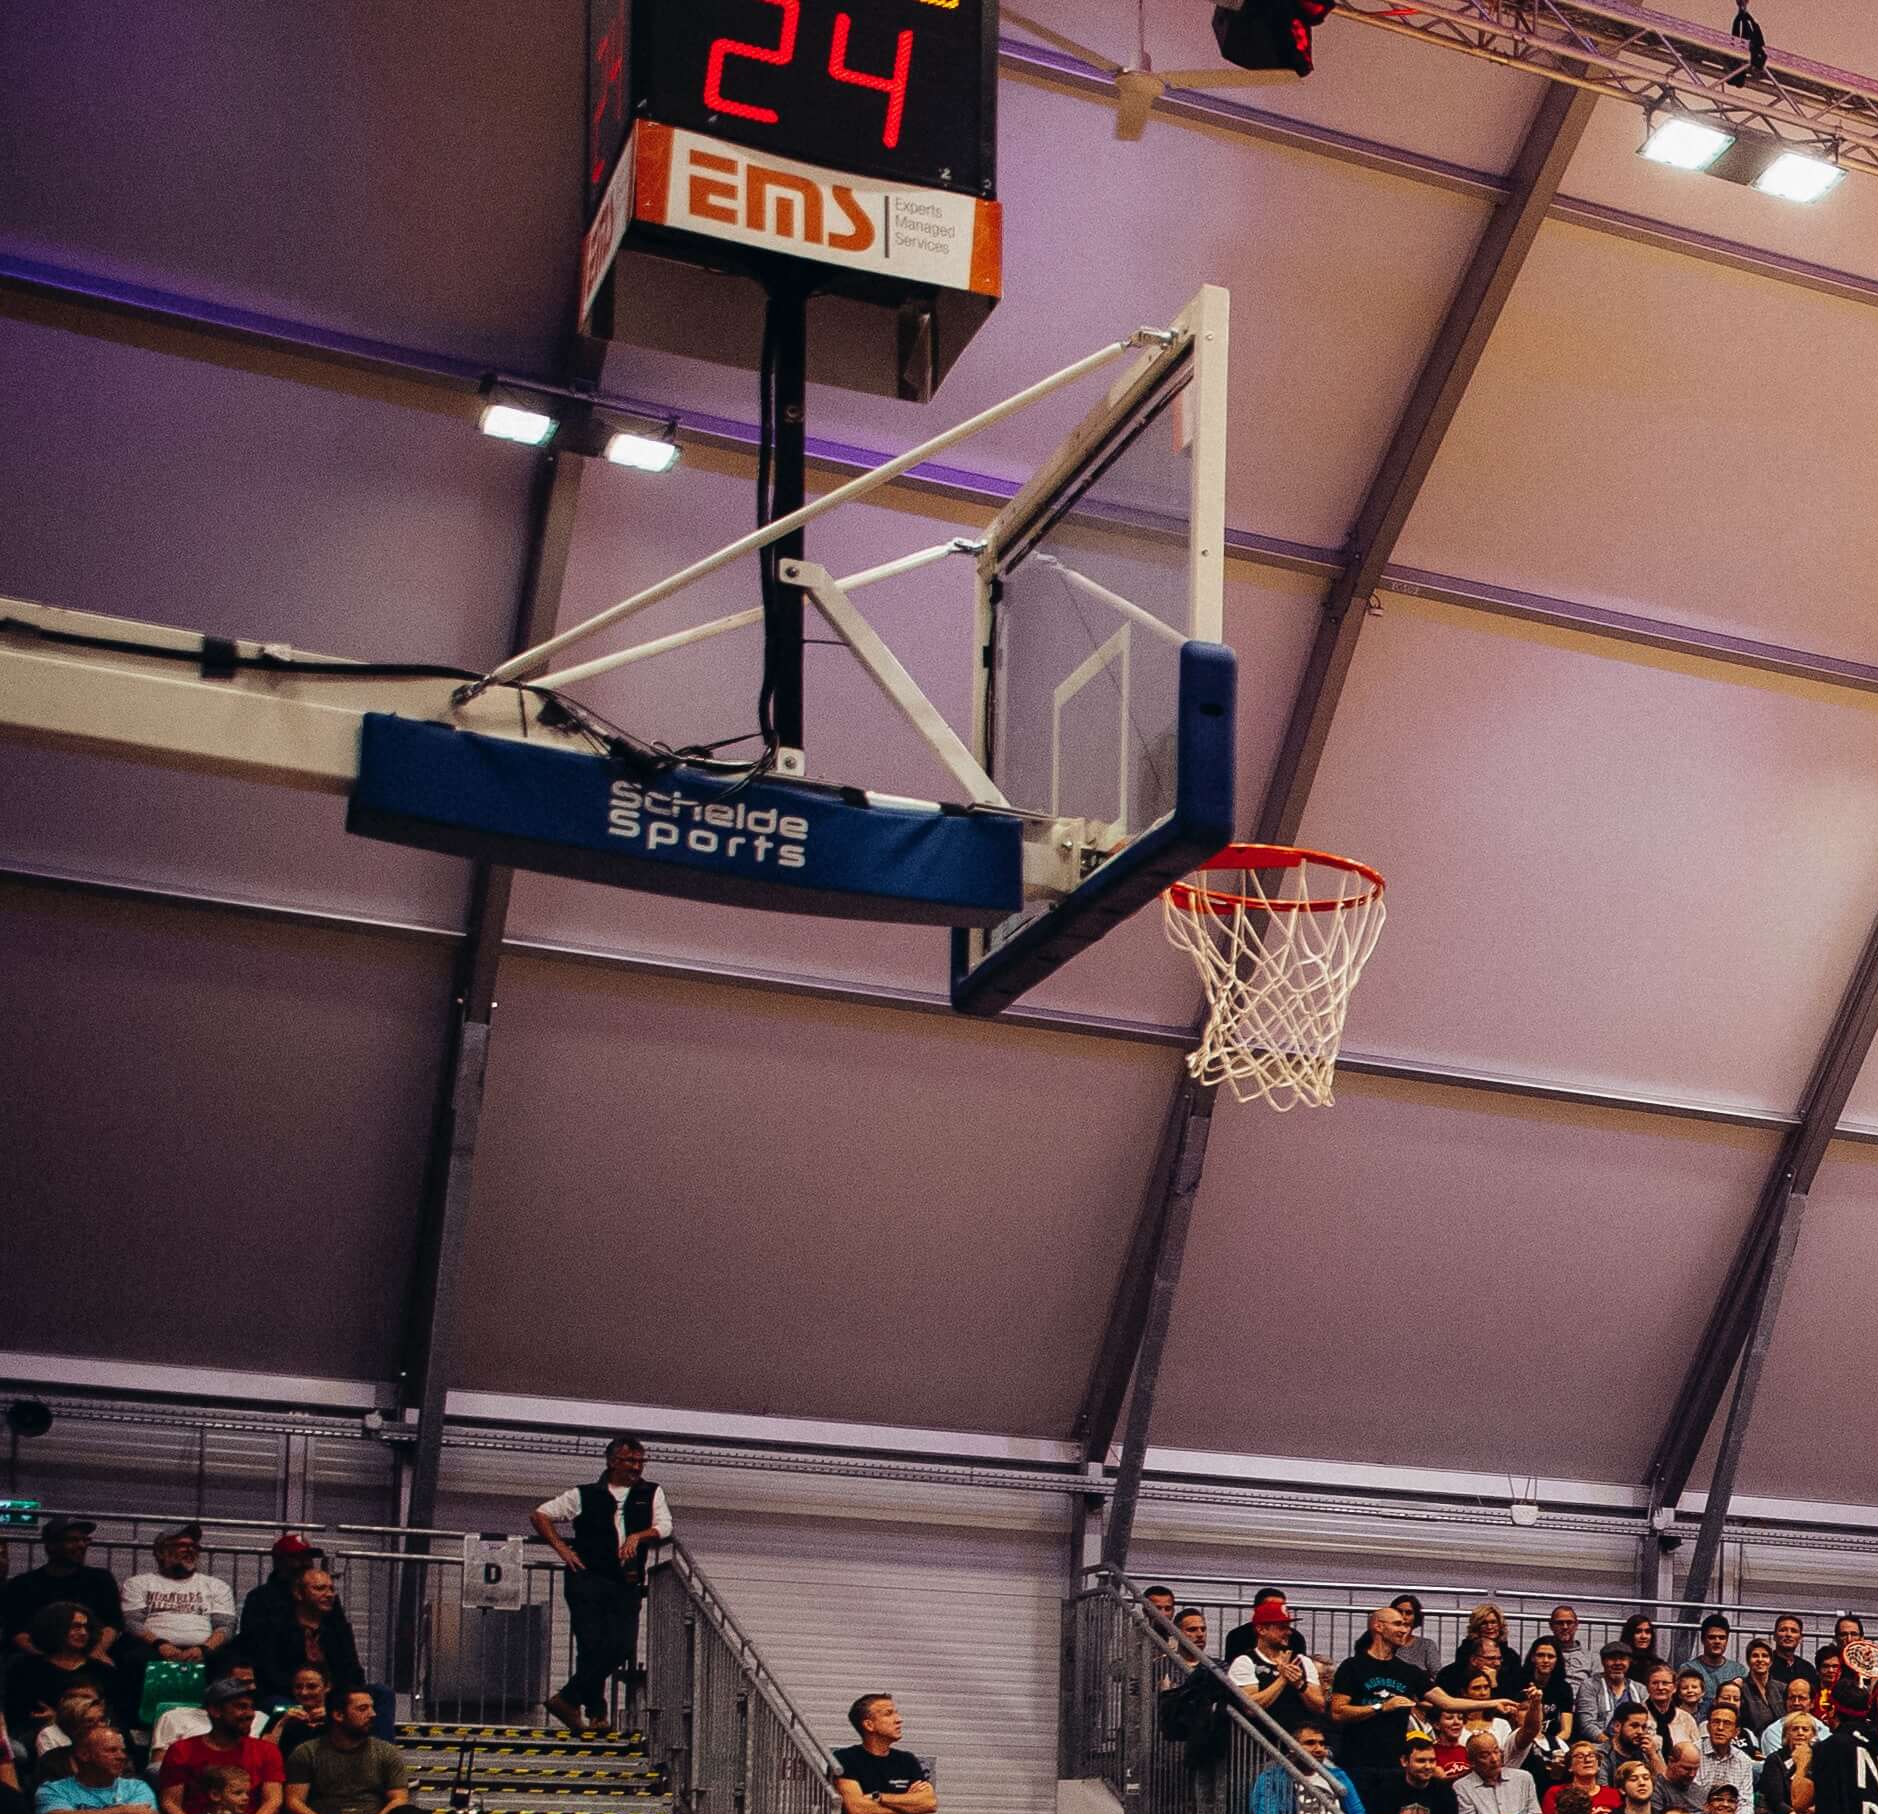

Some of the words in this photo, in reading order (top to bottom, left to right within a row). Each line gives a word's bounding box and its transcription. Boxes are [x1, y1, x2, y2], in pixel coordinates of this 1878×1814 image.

[703, 0, 914, 149] 24
[895, 196, 943, 218] Experts
[895, 214, 955, 239] Managed
[895, 231, 950, 255] Services
[609, 780, 809, 841] Schelde
[608, 808, 806, 868] Sports
[483, 1562, 502, 1585] D
